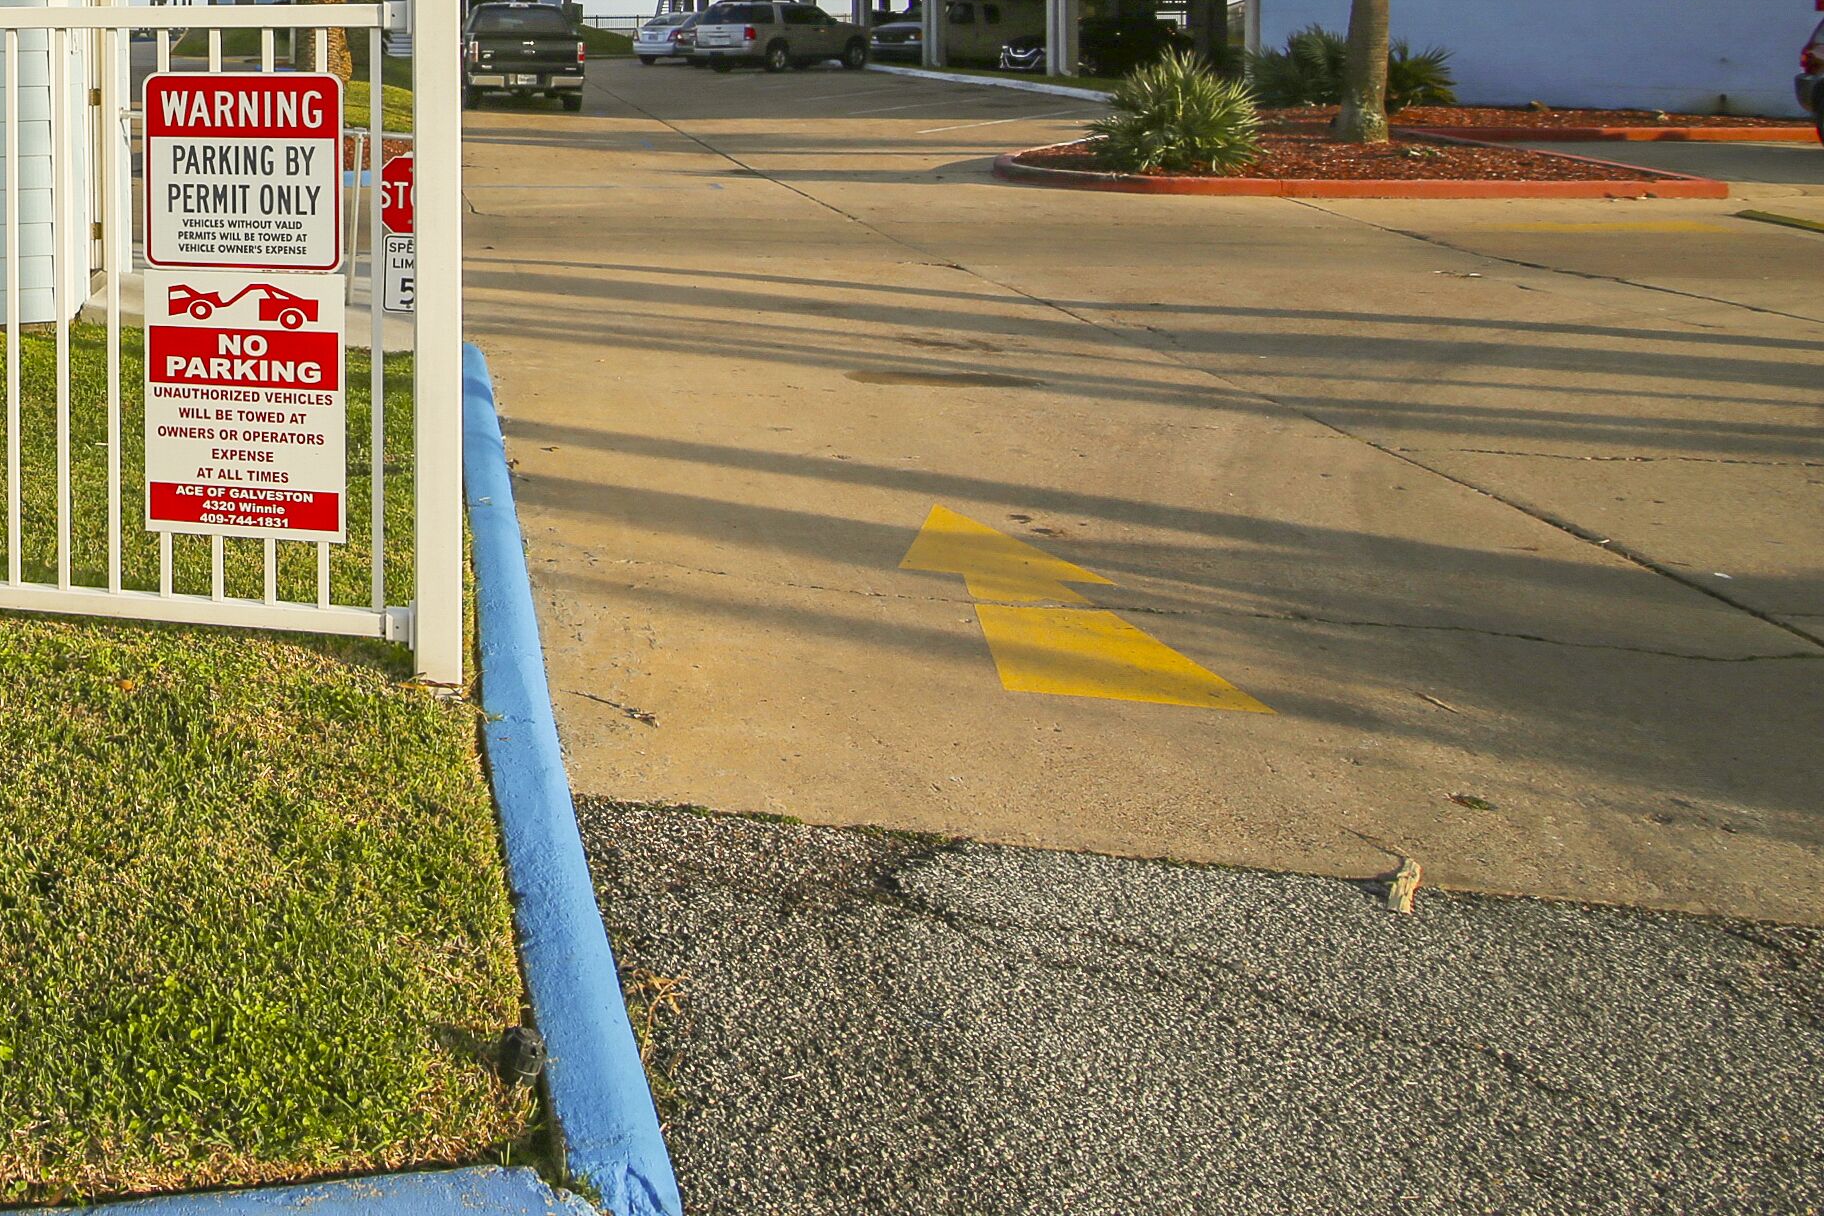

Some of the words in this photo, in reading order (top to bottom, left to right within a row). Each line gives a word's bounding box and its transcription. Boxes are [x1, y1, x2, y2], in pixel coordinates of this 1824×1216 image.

[160, 90, 323, 128] WARNING
[172, 145, 275, 176] PARKING
[286, 146, 315, 176] BY
[168, 184, 250, 214] PERMIT
[259, 185, 321, 215] ONLY
[182, 219, 225, 228] VEHICLES
[227, 220, 272, 229] WITHOUT
[274, 221, 303, 230] VALID
[178, 231, 217, 241] PERMITS
[219, 232, 241, 241] WILL
[244, 233, 255, 242] BE
[258, 233, 293, 242] TOWED
[295, 234, 307, 243] AT
[178, 244, 215, 253] VEHICLE
[218, 244, 263, 254] OWNER'S
[265, 245, 307, 255] EXPENSE
[218, 333, 268, 356] NO
[166, 356, 322, 383] PARKING
[153, 386, 260, 402] UNAUTHORIZED
[264, 392, 333, 406] VEHICLES
[179, 407, 211, 420] WILL
[215, 409, 233, 421] BE
[237, 410, 285, 424] TOWED
[289, 413, 307, 425] AT
[157, 425, 215, 440] OWNERS
[219, 429, 238, 441] OR
[242, 430, 325, 445] OPERATORS
[211, 448, 274, 463] EXPENSE
[196, 467, 214, 479] AT
[217, 468, 242, 480] ALL
[246, 470, 289, 484] TIMES
[176, 485, 204, 497] ACE
[207, 487, 226, 497] OF
[229, 488, 314, 503] GALVESTON
[202, 500, 236, 512] 4320
[239, 502, 285, 515] Winnie
[199, 513, 289, 528] 409-744-1831
